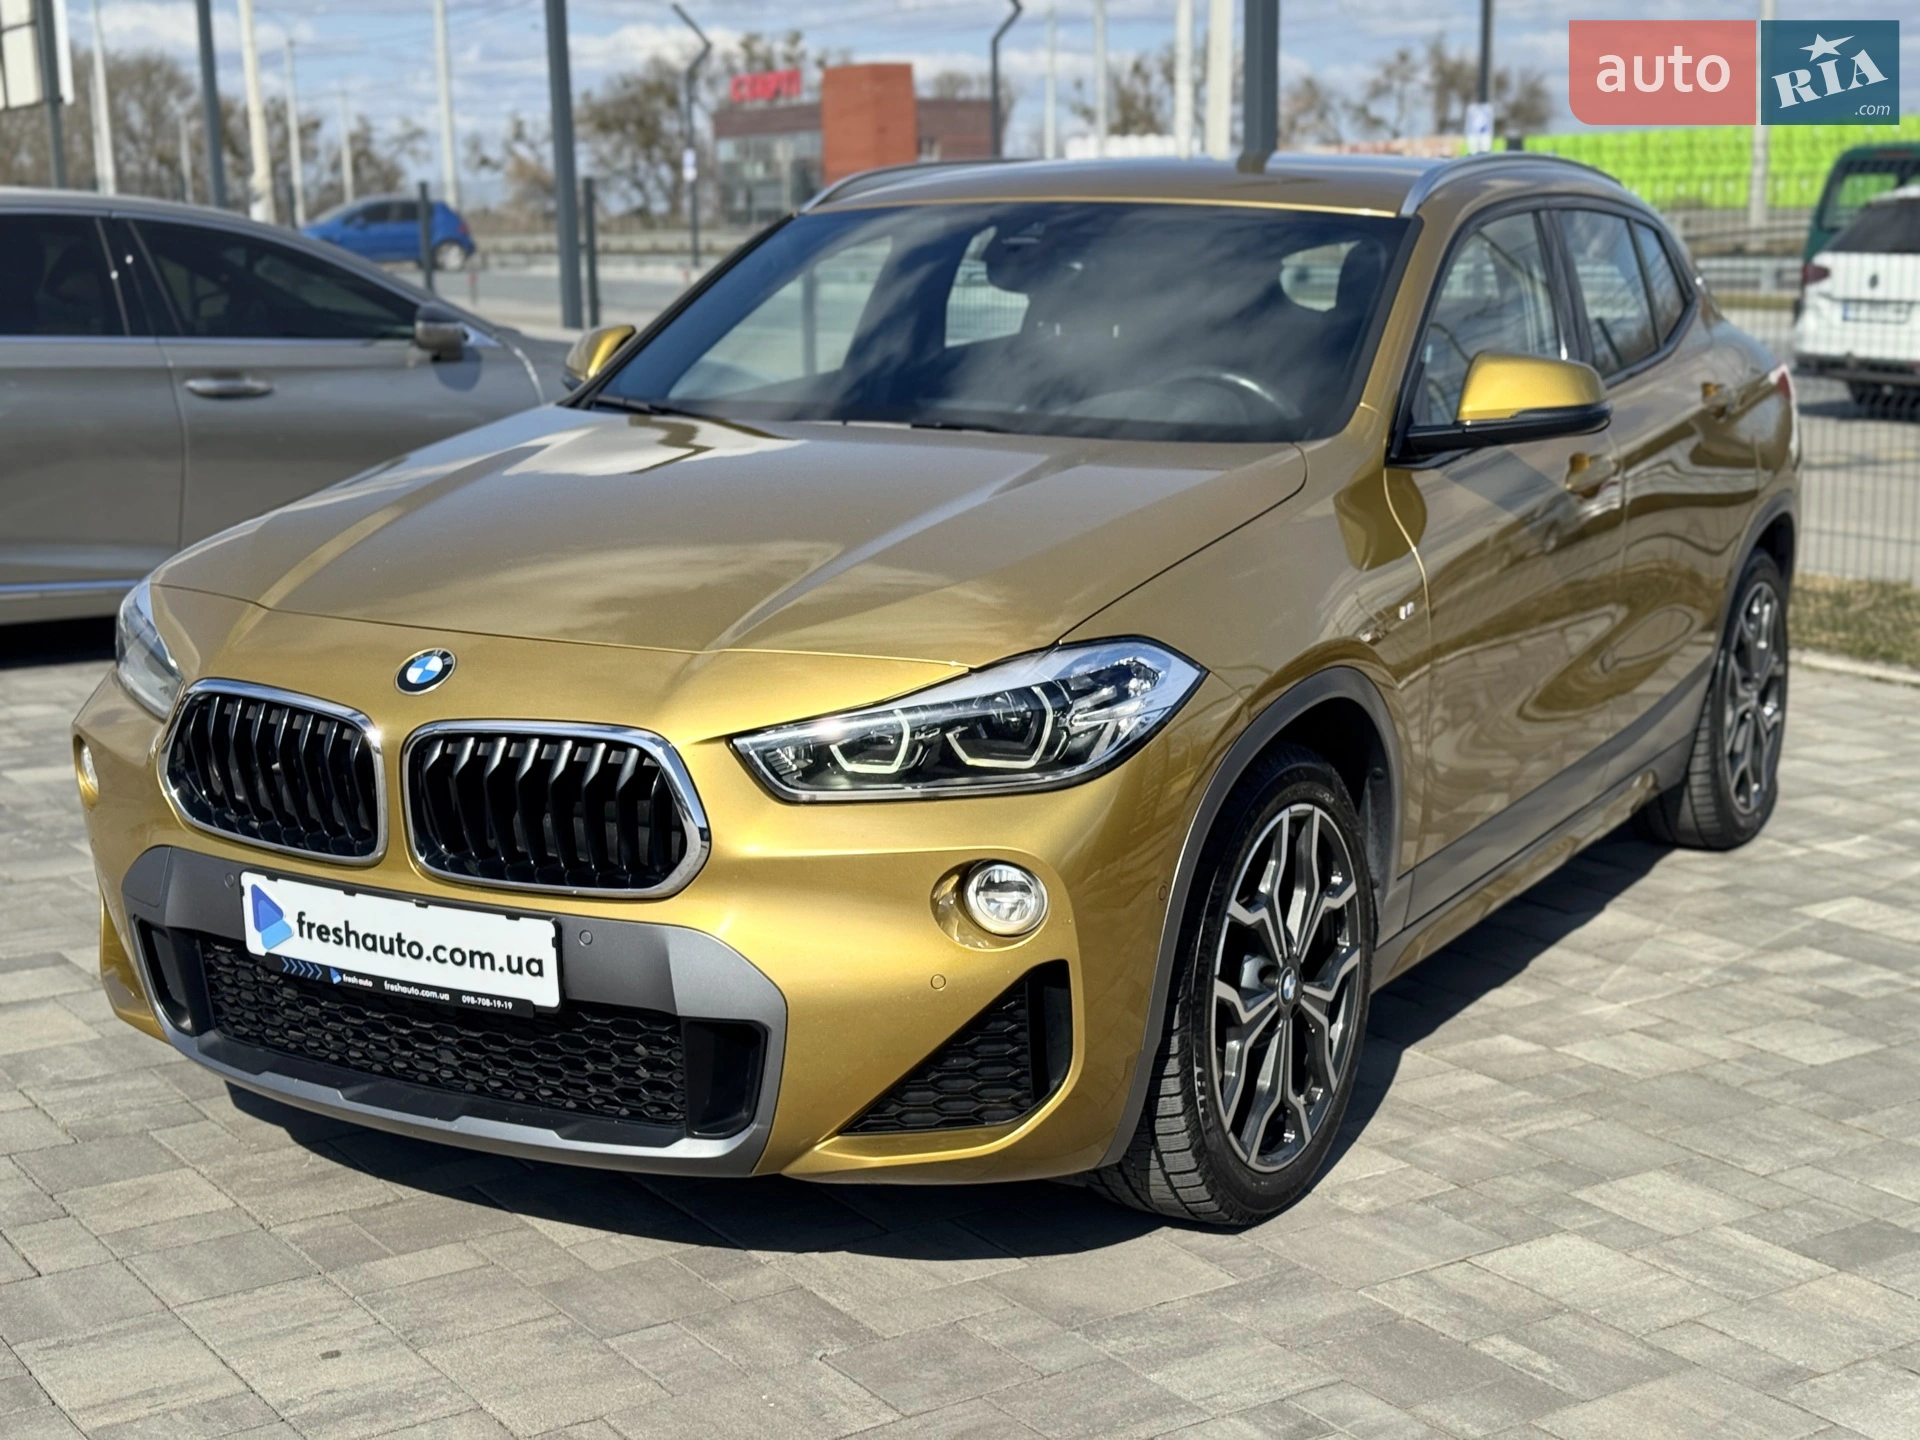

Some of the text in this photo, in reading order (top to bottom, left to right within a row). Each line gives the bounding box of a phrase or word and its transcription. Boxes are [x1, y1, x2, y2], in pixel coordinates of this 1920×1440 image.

[296, 911, 544, 978] freshauto.com.ua
[384, 980, 450, 1001] freshauto.com.ua
[461, 994, 513, 1011] 098-708-19-19
